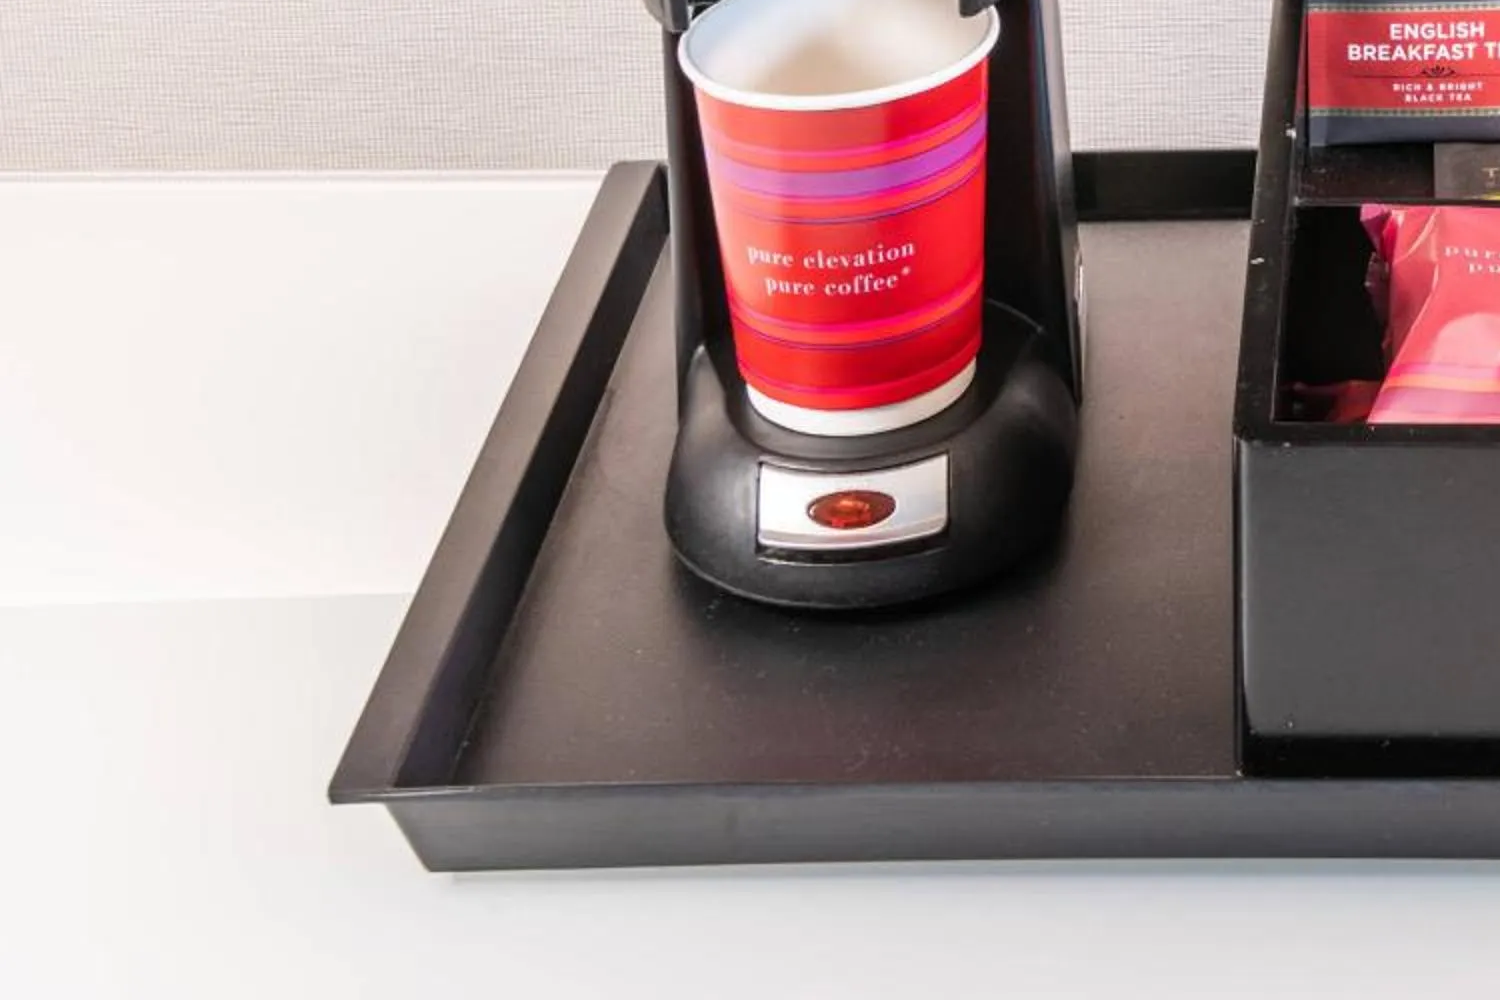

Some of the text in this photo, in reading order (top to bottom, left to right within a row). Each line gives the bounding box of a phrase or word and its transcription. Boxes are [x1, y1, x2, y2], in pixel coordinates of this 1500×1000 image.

[1389, 21, 1486, 41] ENGLISH
[1347, 42, 1478, 62] BREAKFAST
[1392, 82, 1422, 92] RICH
[1439, 81, 1484, 91] BRIGHT
[1404, 92, 1473, 104] BLACK TEA
[746, 242, 917, 270] pure elevation
[764, 276, 816, 297] pure
